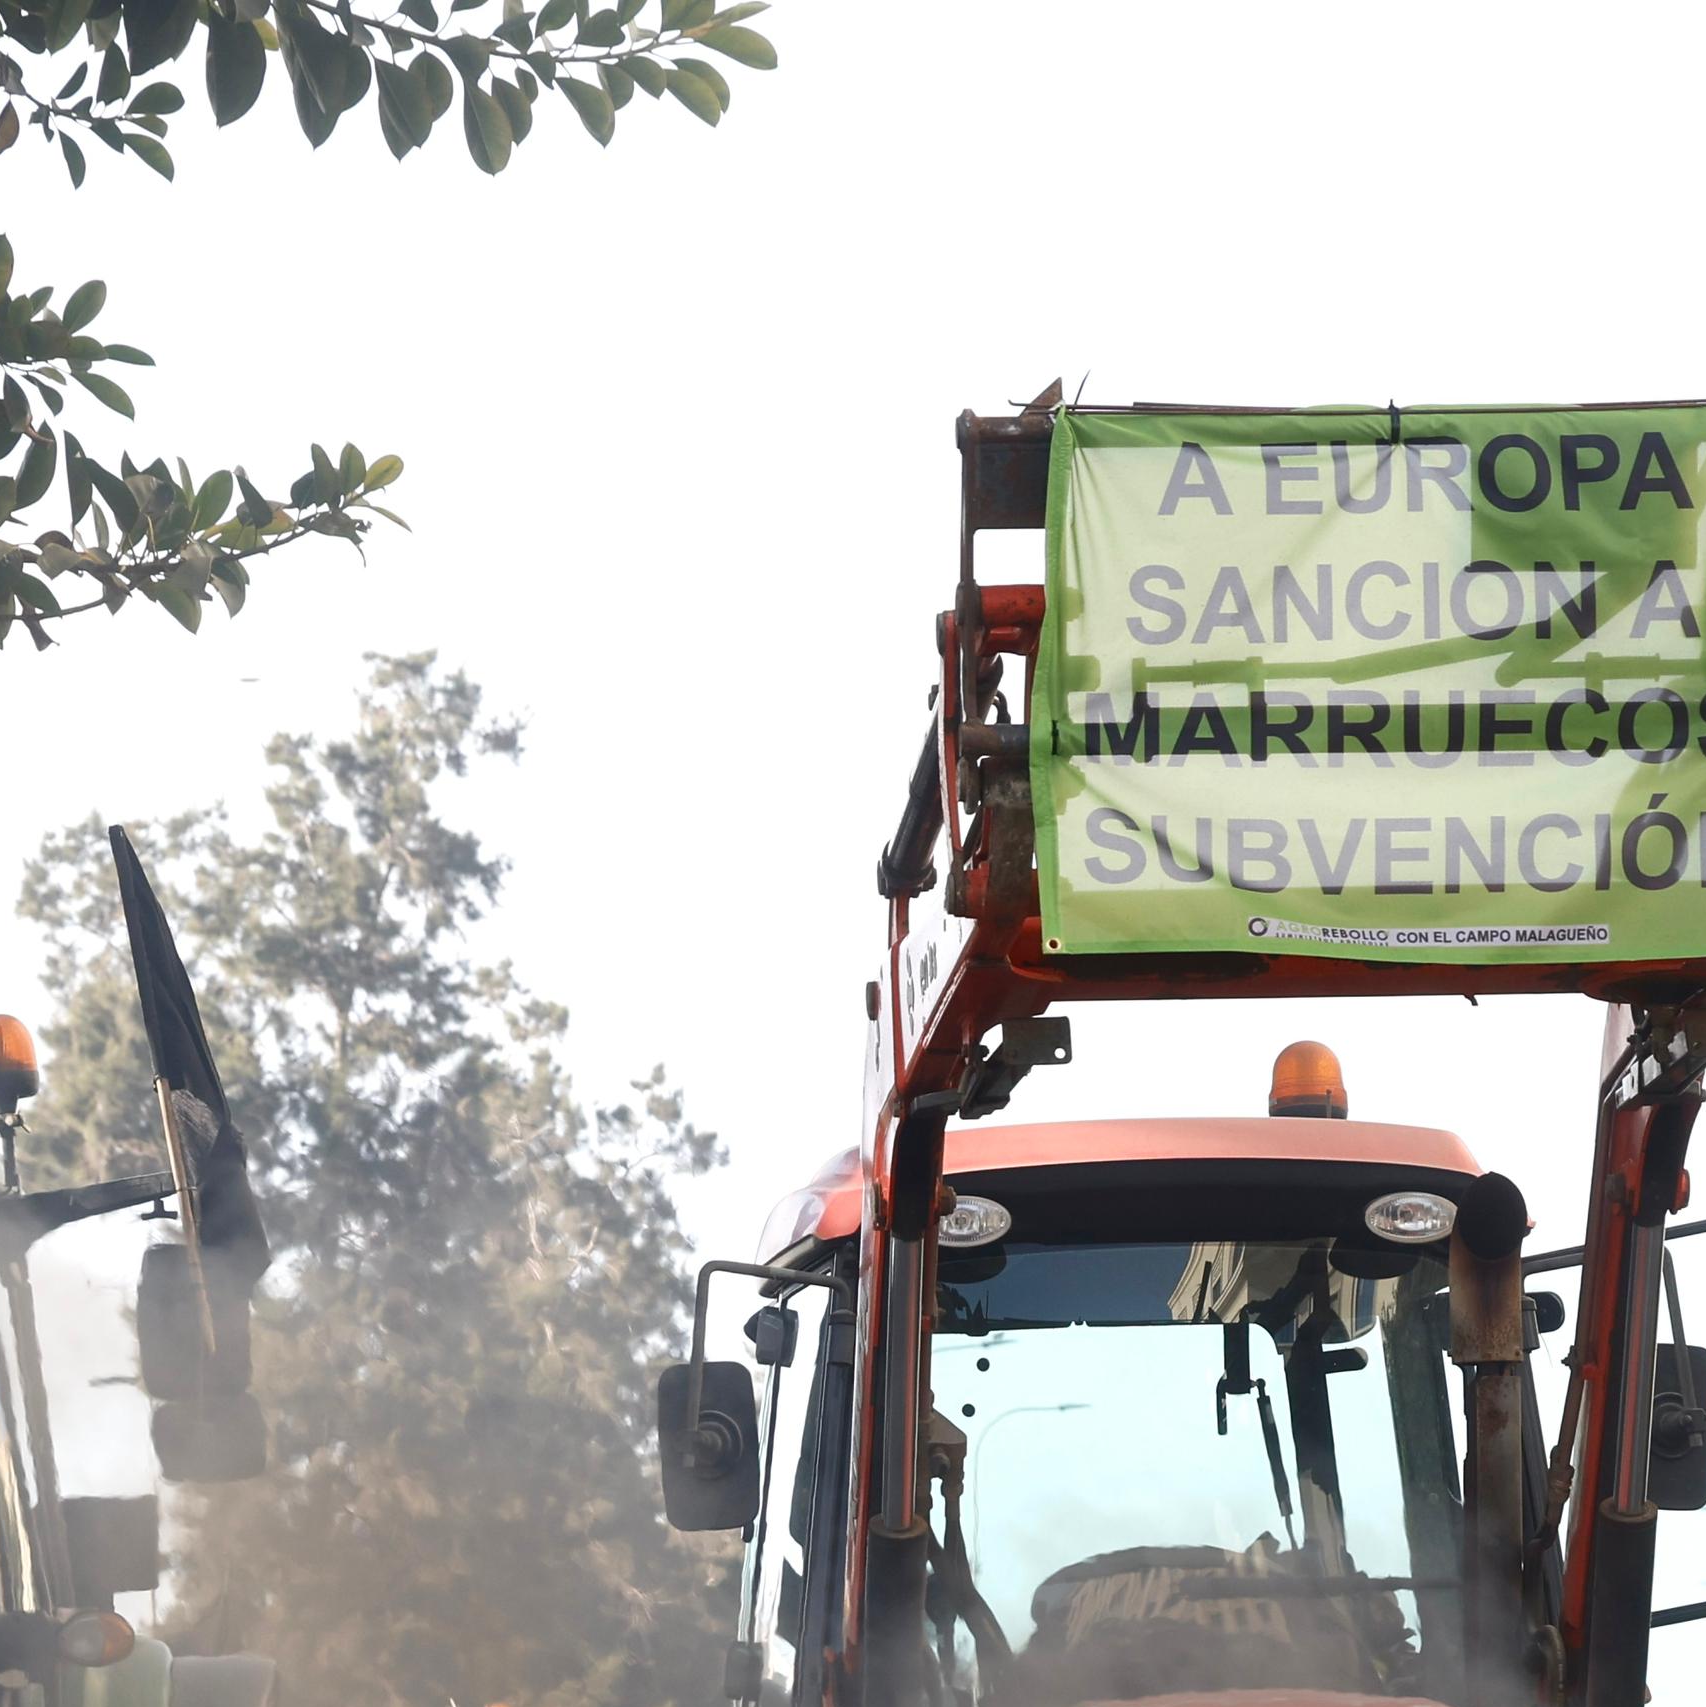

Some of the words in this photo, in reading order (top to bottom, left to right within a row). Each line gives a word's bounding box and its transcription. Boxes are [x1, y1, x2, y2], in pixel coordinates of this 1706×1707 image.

[1158, 441, 1232, 516] A
[1260, 431, 1694, 515] EUROPA
[1125, 560, 1596, 645] SANCION
[1630, 559, 1701, 639] A
[1396, 931, 1429, 944] CON
[1433, 931, 1452, 943] EL
[1455, 929, 1511, 943] CAMPO
[1515, 925, 1608, 942] MALAGUEÑO
